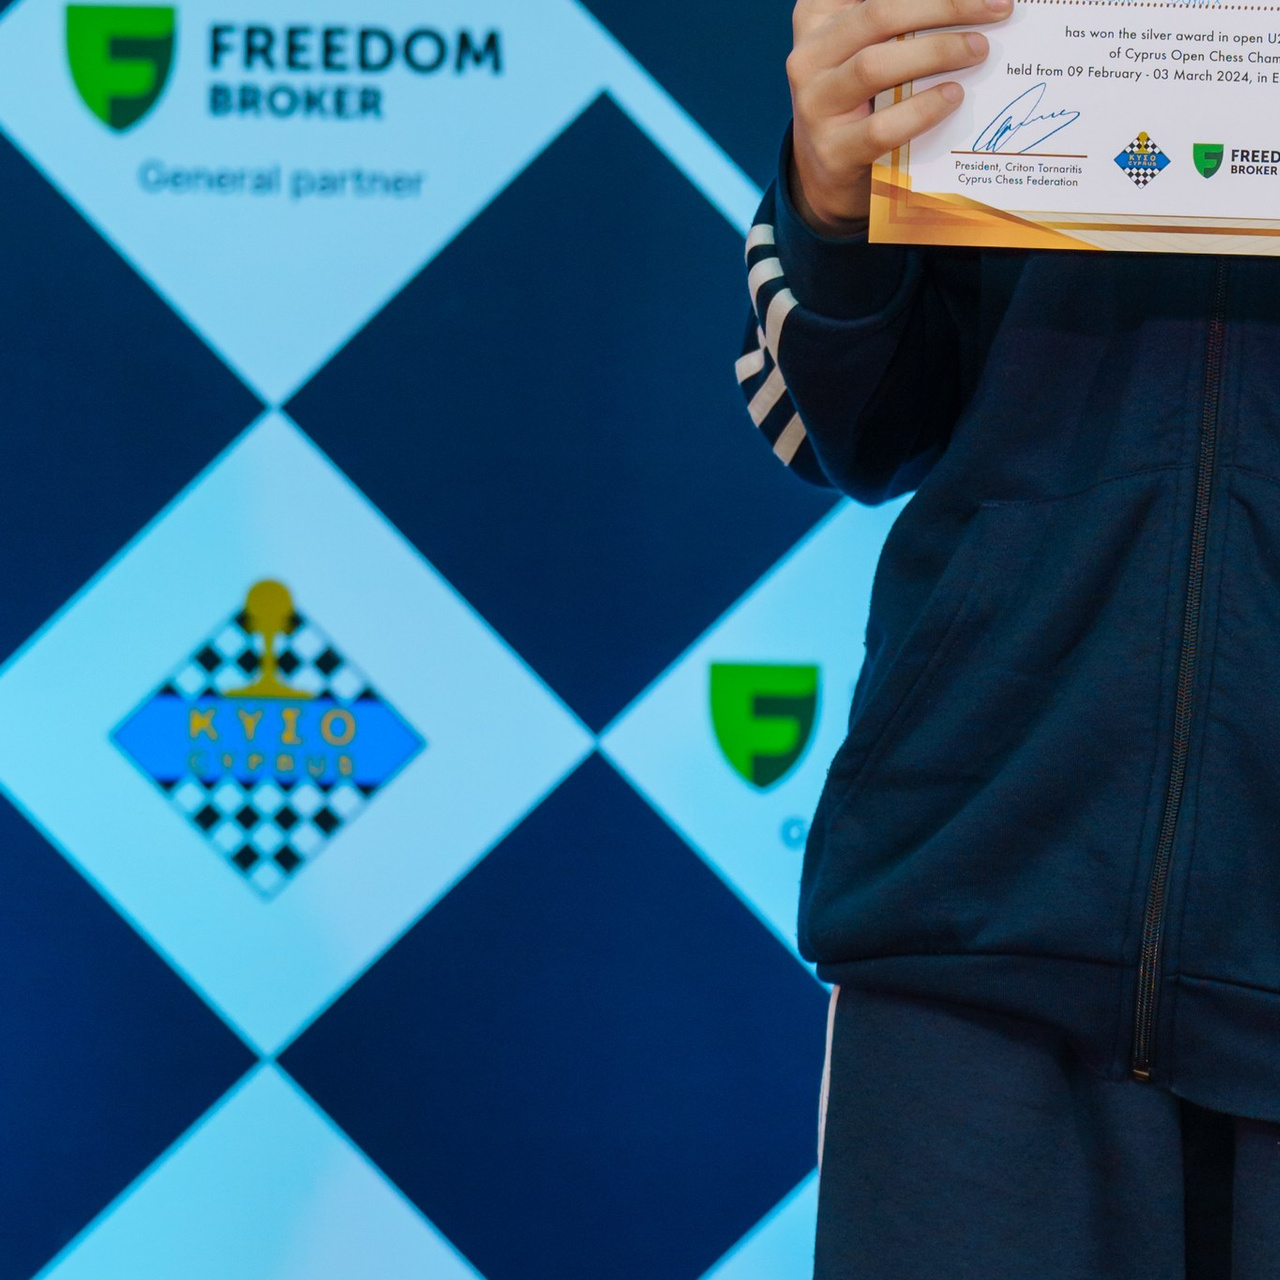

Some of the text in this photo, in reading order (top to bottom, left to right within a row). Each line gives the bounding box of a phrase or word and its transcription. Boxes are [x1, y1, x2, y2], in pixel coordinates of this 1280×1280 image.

[1065, 25, 1086, 38] has
[1090, 30, 1115, 39] won
[1118, 27, 1137, 40] the
[1141, 28, 1172, 41] silver
[1175, 30, 1214, 42] award
[1218, 31, 1229, 43] in
[1233, 34, 1263, 46] open
[209, 24, 504, 75] FREEDOM
[1109, 47, 1122, 59] of
[1125, 48, 1167, 63] Cyprus
[1171, 49, 1205, 64] Open
[1209, 50, 1244, 63] Chess
[1007, 63, 1032, 76] held
[1036, 64, 1063, 77] from
[1067, 66, 1084, 77] 09
[1088, 66, 1142, 82] February
[1153, 68, 1169, 80] 03
[1174, 69, 1212, 81] March
[1217, 70, 1252, 84] 2024,
[1257, 72, 1268, 83] in
[208, 83, 384, 120] BROKER
[955, 161, 1083, 174] President, Criton Tornaritis
[1231, 165, 1278, 175] BROKER
[138, 159, 426, 201] General partner
[958, 173, 1078, 187] Cyprus Chess Federation
